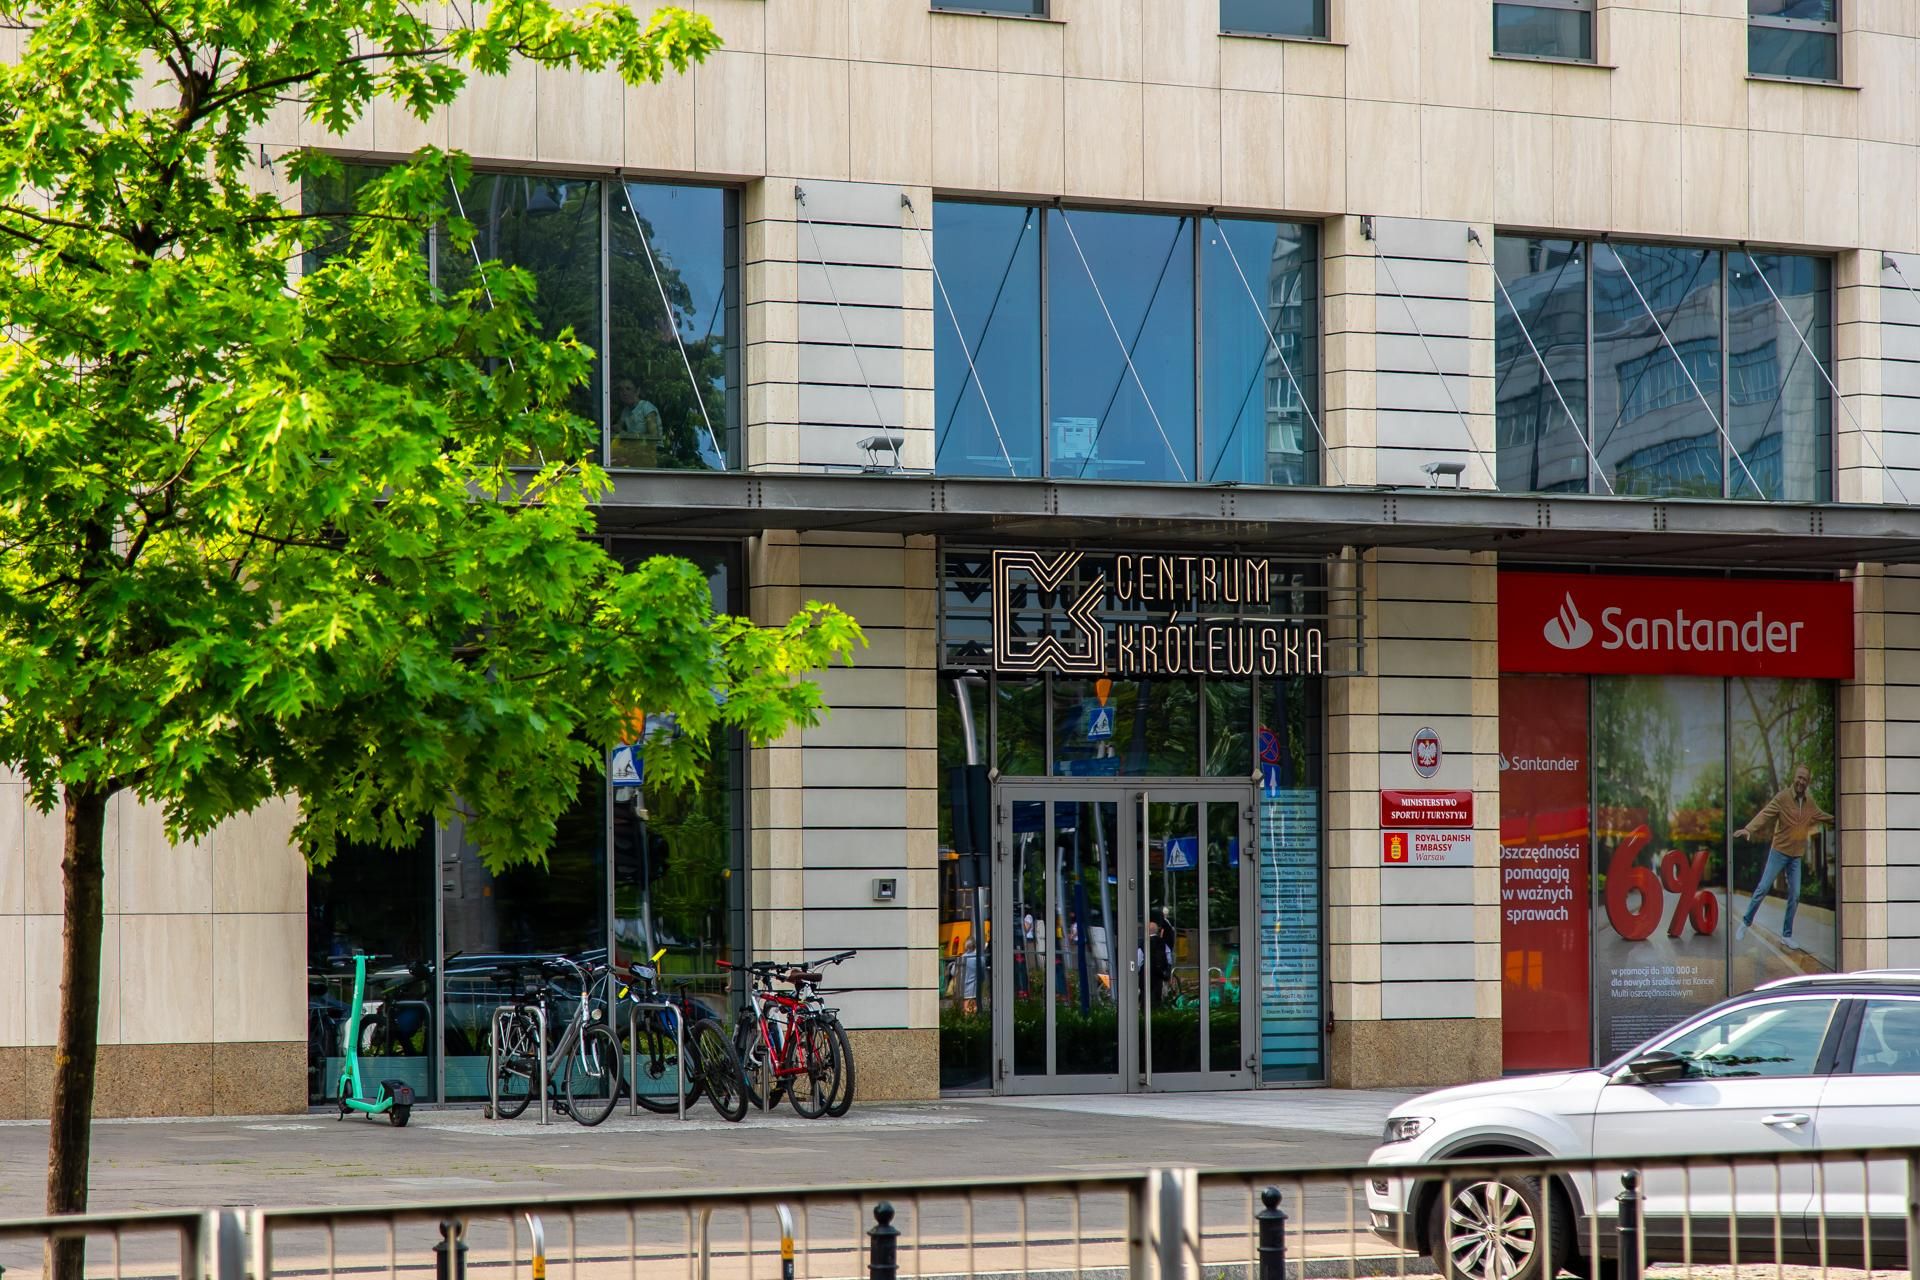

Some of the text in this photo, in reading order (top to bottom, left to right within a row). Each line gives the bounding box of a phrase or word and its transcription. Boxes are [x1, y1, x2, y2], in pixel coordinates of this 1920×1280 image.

[1116, 555, 1270, 603] CENTRUM
[1601, 606, 1804, 653] Santander
[1117, 610, 1323, 675] KRÓLEWSKA
[1512, 756, 1580, 771] Santander
[1401, 798, 1457, 807] MINISTERSTWO
[1391, 811, 1467, 820] SPORTU I TURYSTYKI
[1415, 834, 1471, 842] ROYAL DANISH
[1415, 843, 1452, 852] EMBASSY
[1415, 852, 1445, 861] Warsaw
[1504, 864, 1570, 884] pomagają
[1605, 824, 1719, 941] 6%
[1501, 885, 1573, 904] w ważnych
[1506, 905, 1569, 925] sprawach
[1611, 968, 1618, 976] w
[1619, 966, 1650, 977] promocji
[1651, 966, 1660, 976] do
[1662, 966, 1675, 975] 100
[1676, 966, 1690, 975] 000
[1611, 978, 1622, 987] dla
[1623, 978, 1650, 988] nowych
[1611, 989, 1629, 998] Multi
